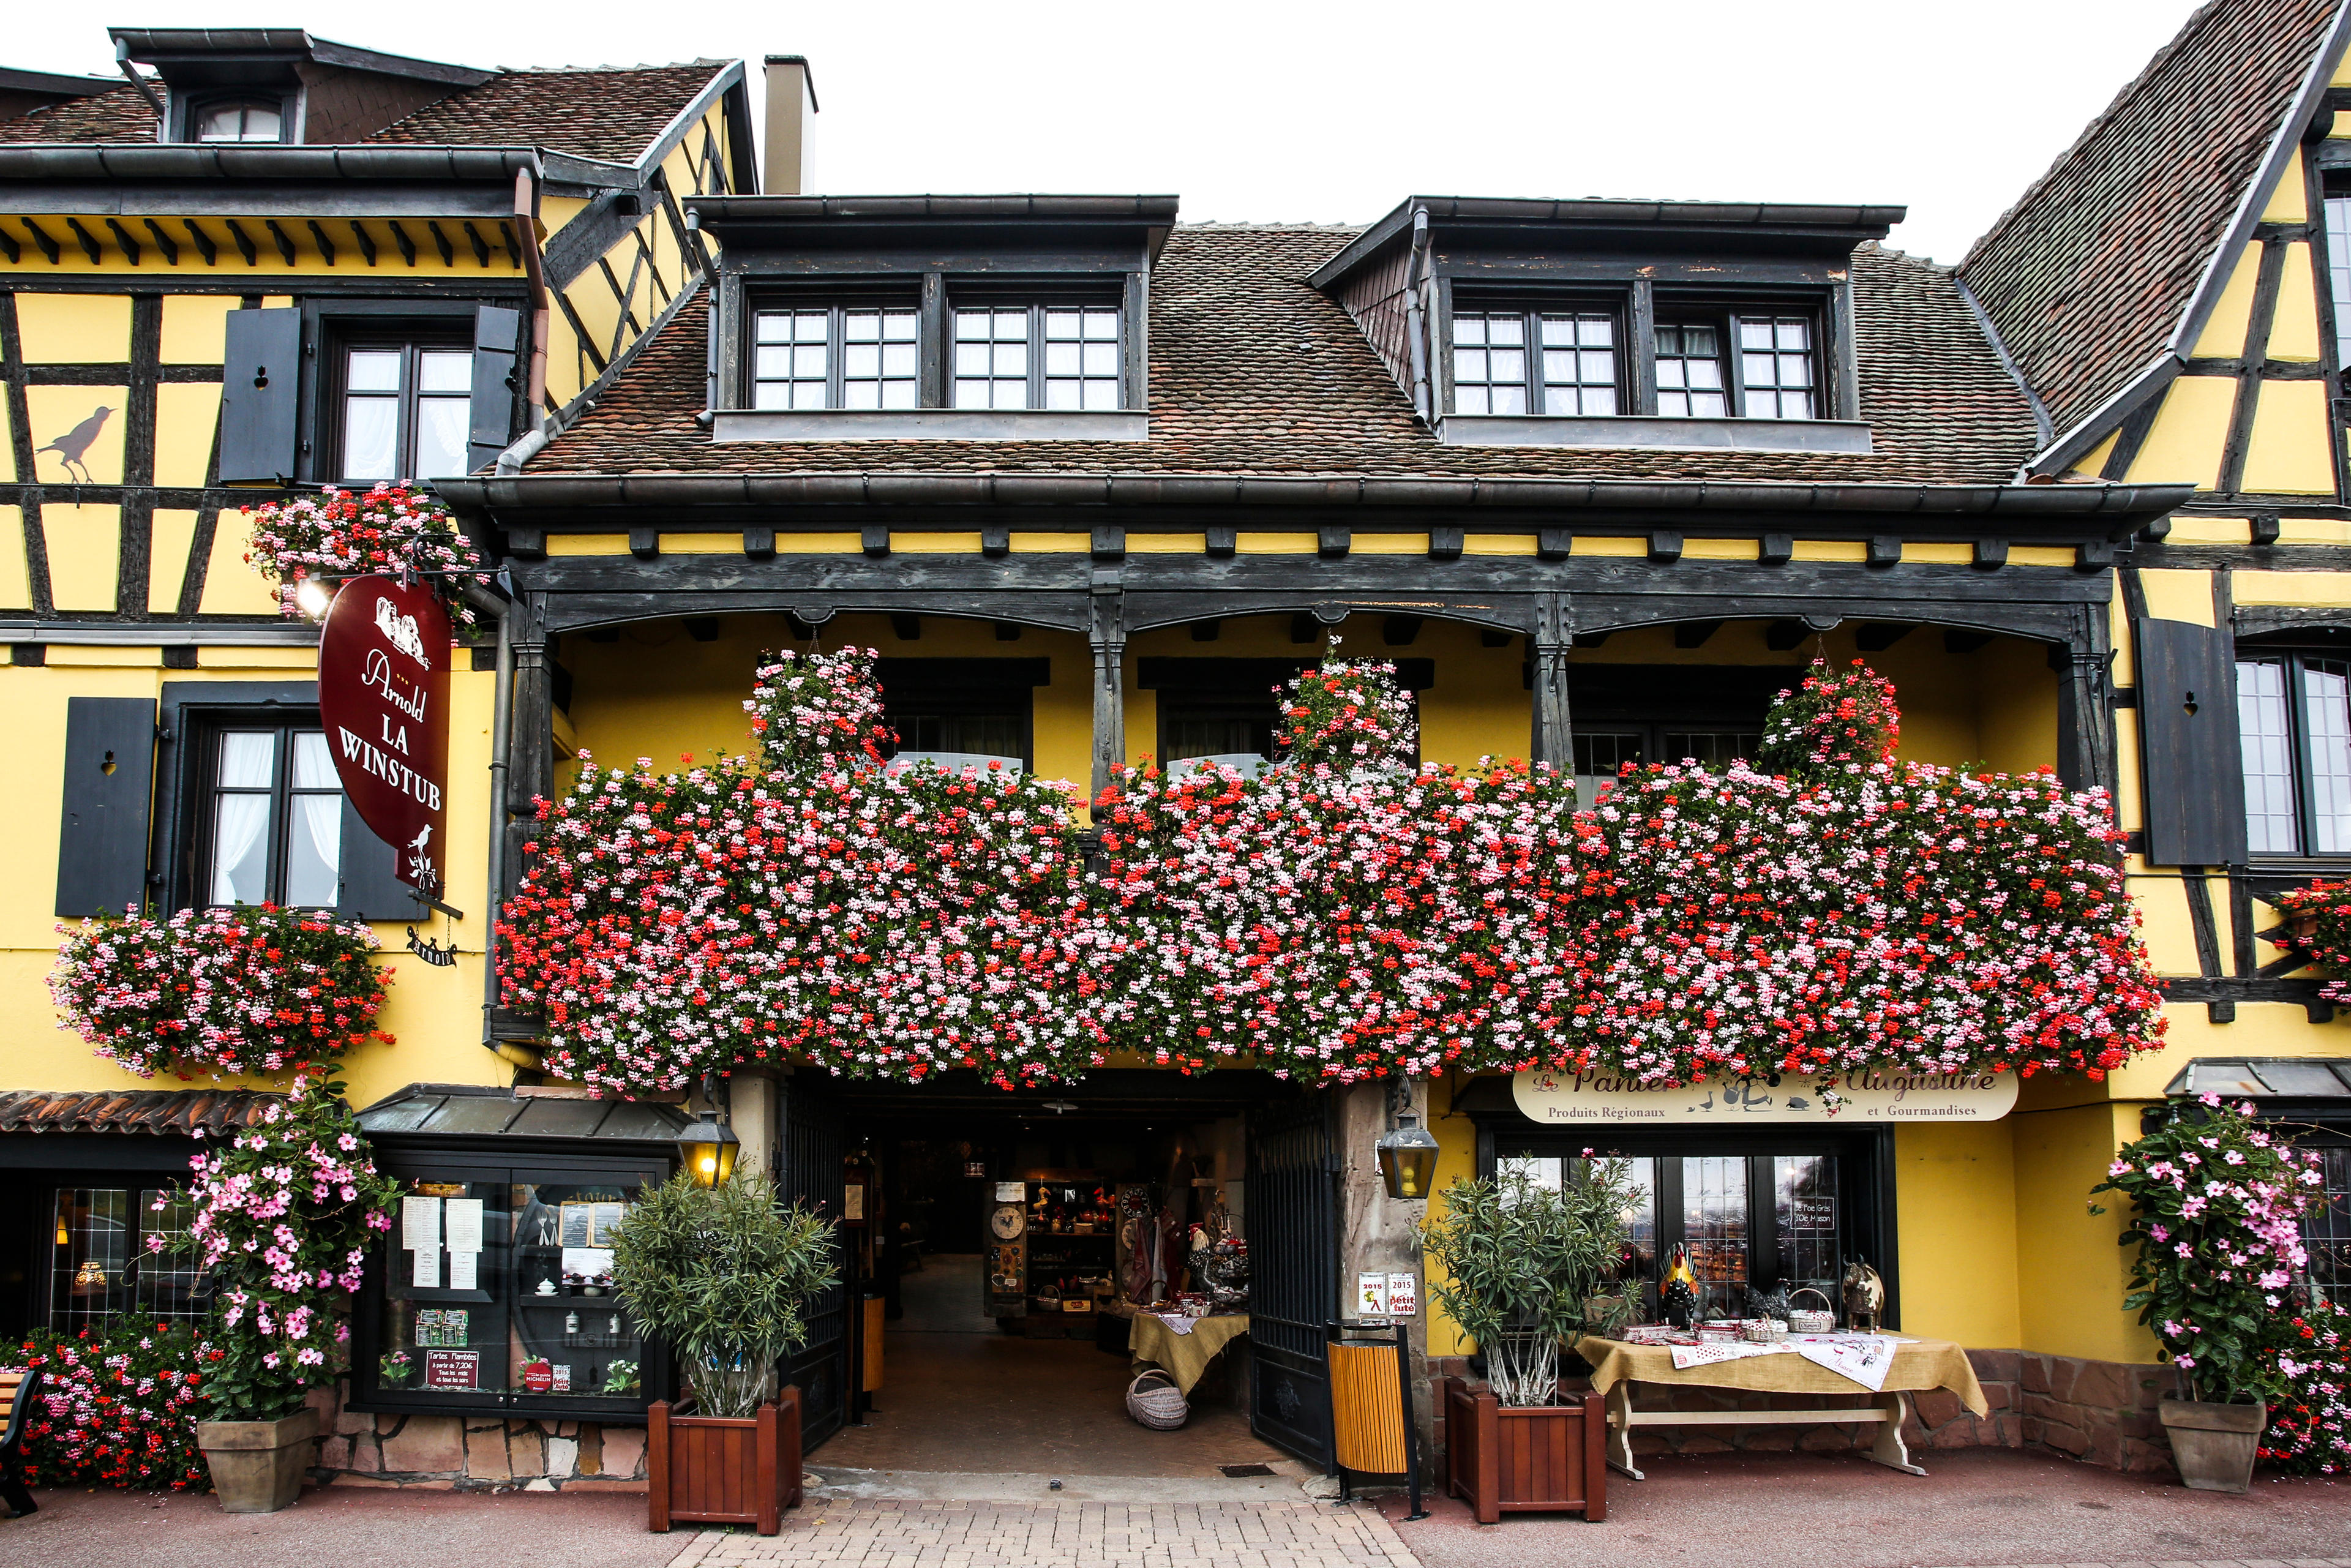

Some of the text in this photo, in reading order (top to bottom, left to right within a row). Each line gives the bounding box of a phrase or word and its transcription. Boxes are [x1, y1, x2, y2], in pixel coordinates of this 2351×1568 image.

[361, 648, 427, 724] Arnold
[381, 713, 409, 756] LA
[339, 726, 441, 811] WINSTUB
[413, 939, 451, 966] Arnold
[1532, 1074, 1559, 1092] Le
[1548, 1105, 1977, 1120] Produits Régionaux et Gourmandises
[1390, 1296, 1414, 1305] petit
